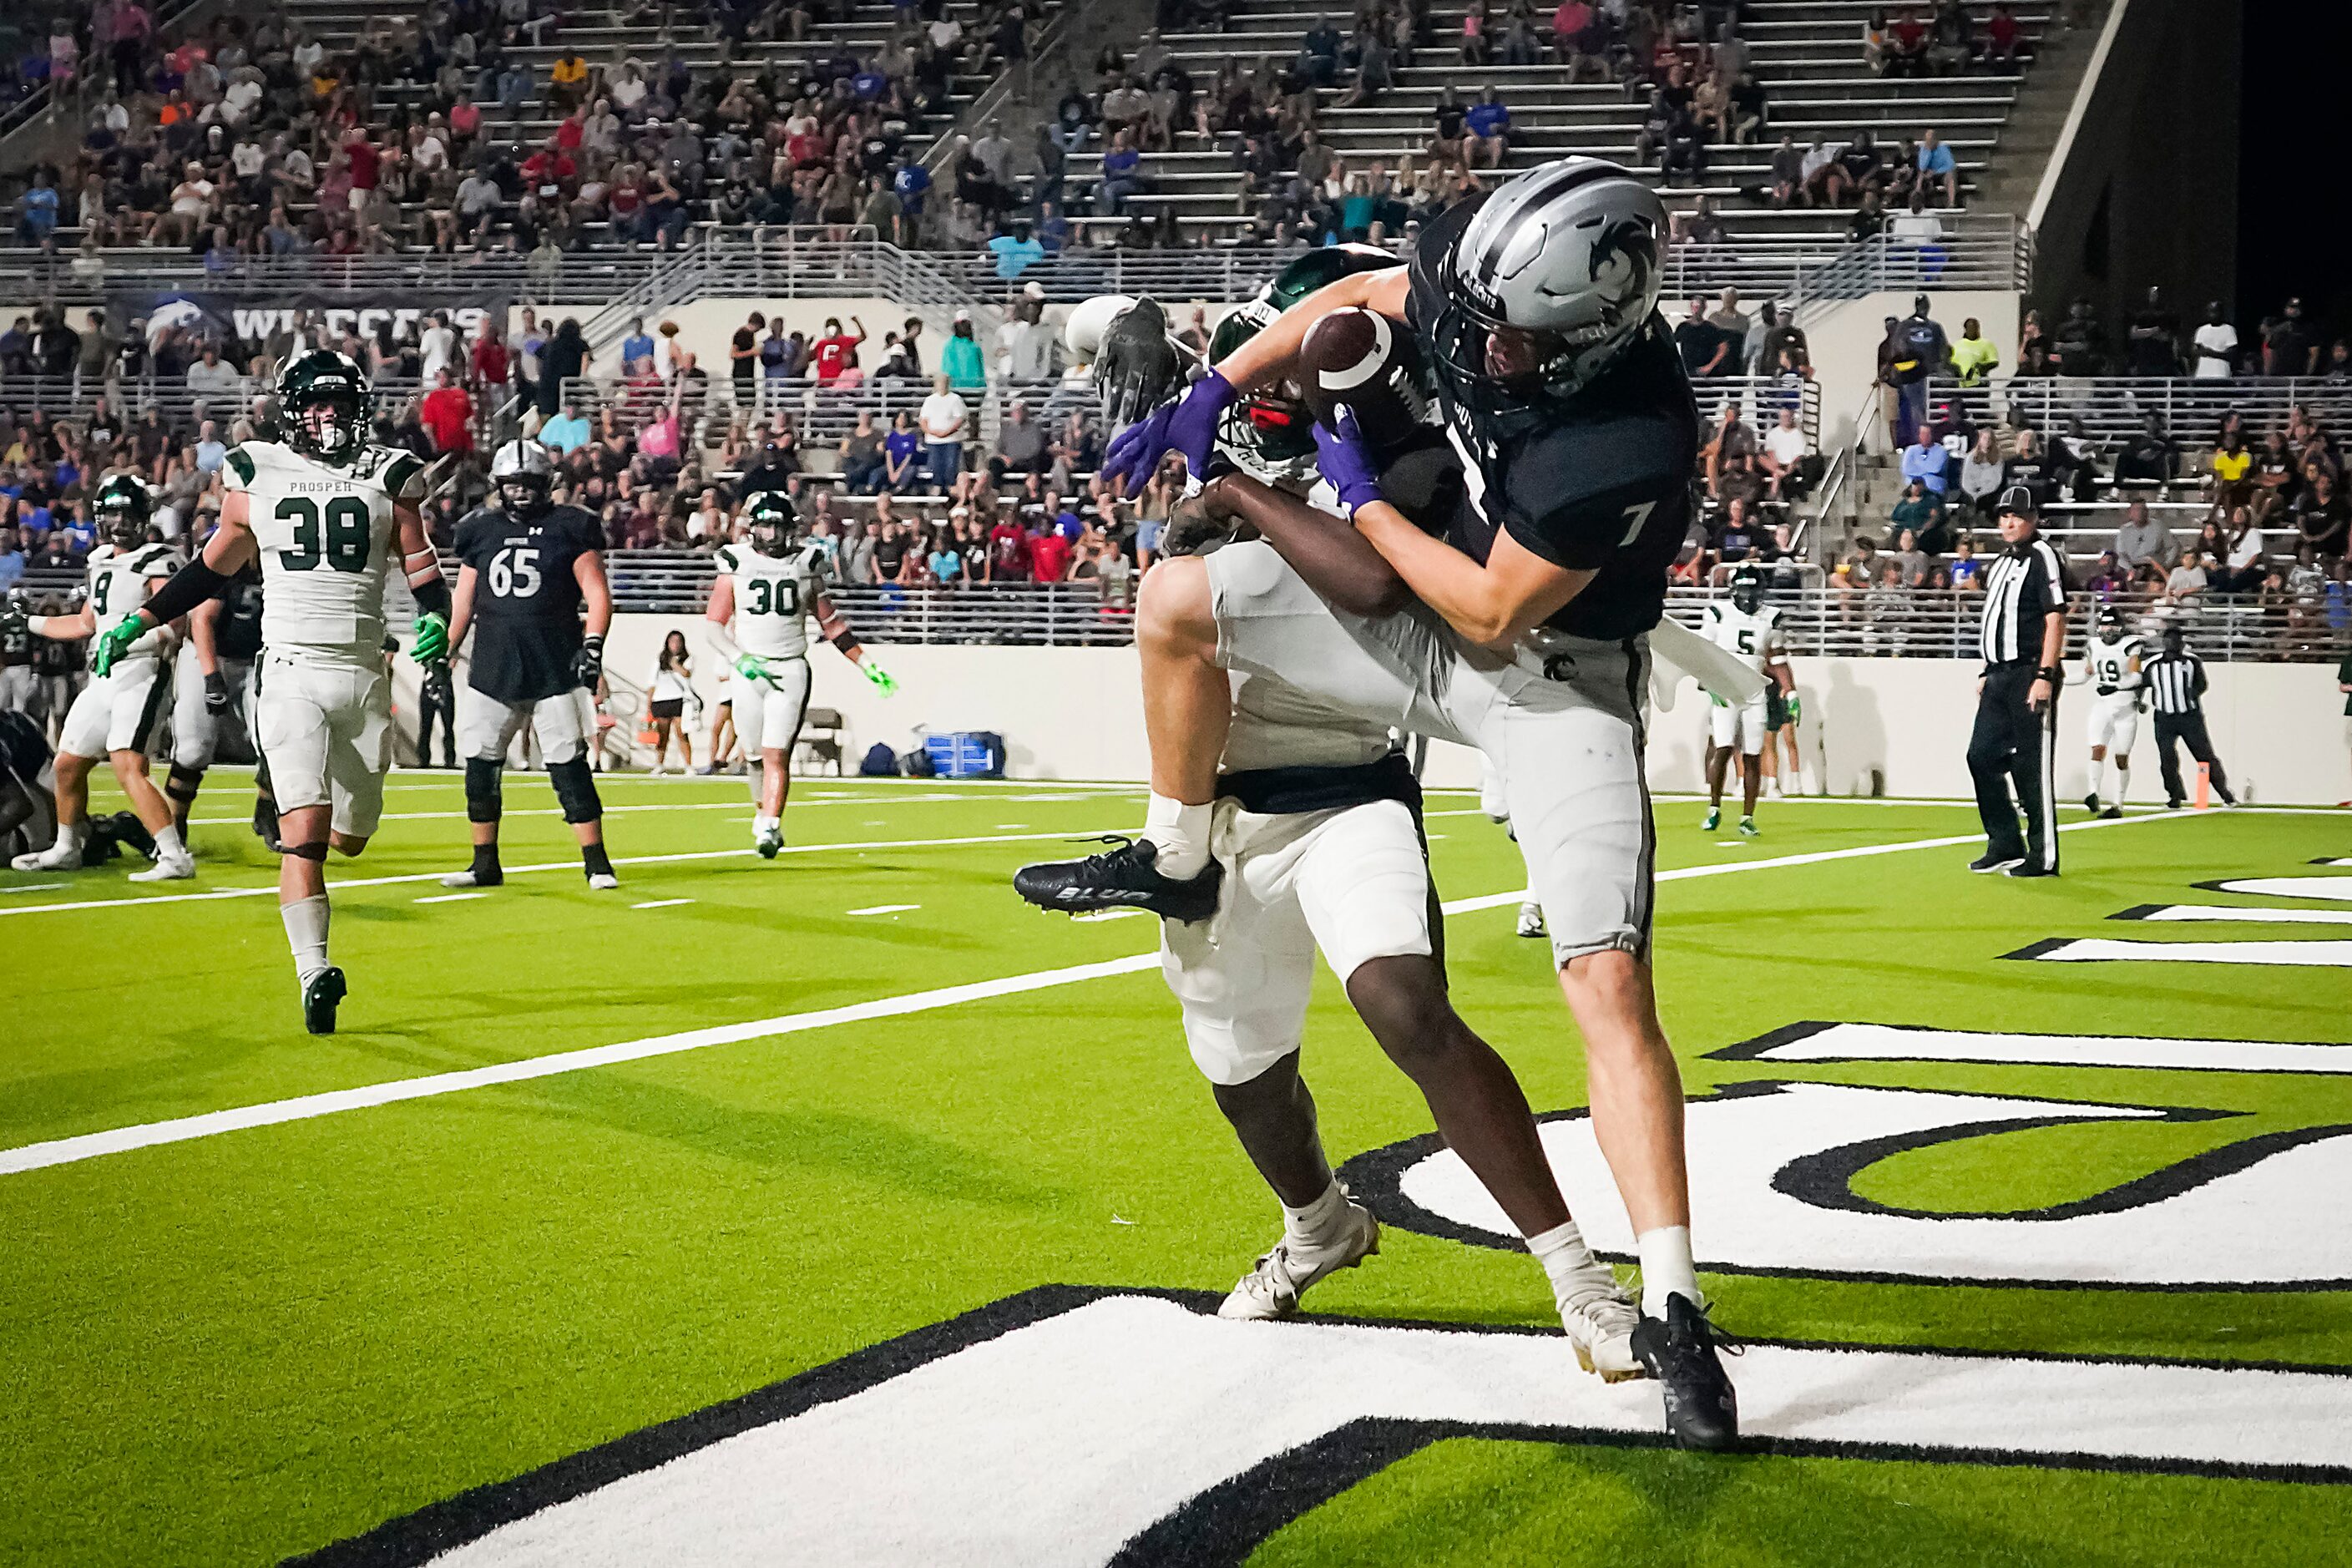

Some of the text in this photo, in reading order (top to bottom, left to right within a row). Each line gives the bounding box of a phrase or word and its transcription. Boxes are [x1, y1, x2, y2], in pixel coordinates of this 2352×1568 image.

[290, 482, 352, 492] PROSPER
[275, 496, 370, 574] 38
[1618, 500, 1657, 548] 7
[94, 571, 113, 616] 9
[488, 548, 541, 598] 65
[748, 579, 799, 616] 30
[1737, 630, 1755, 655] 5
